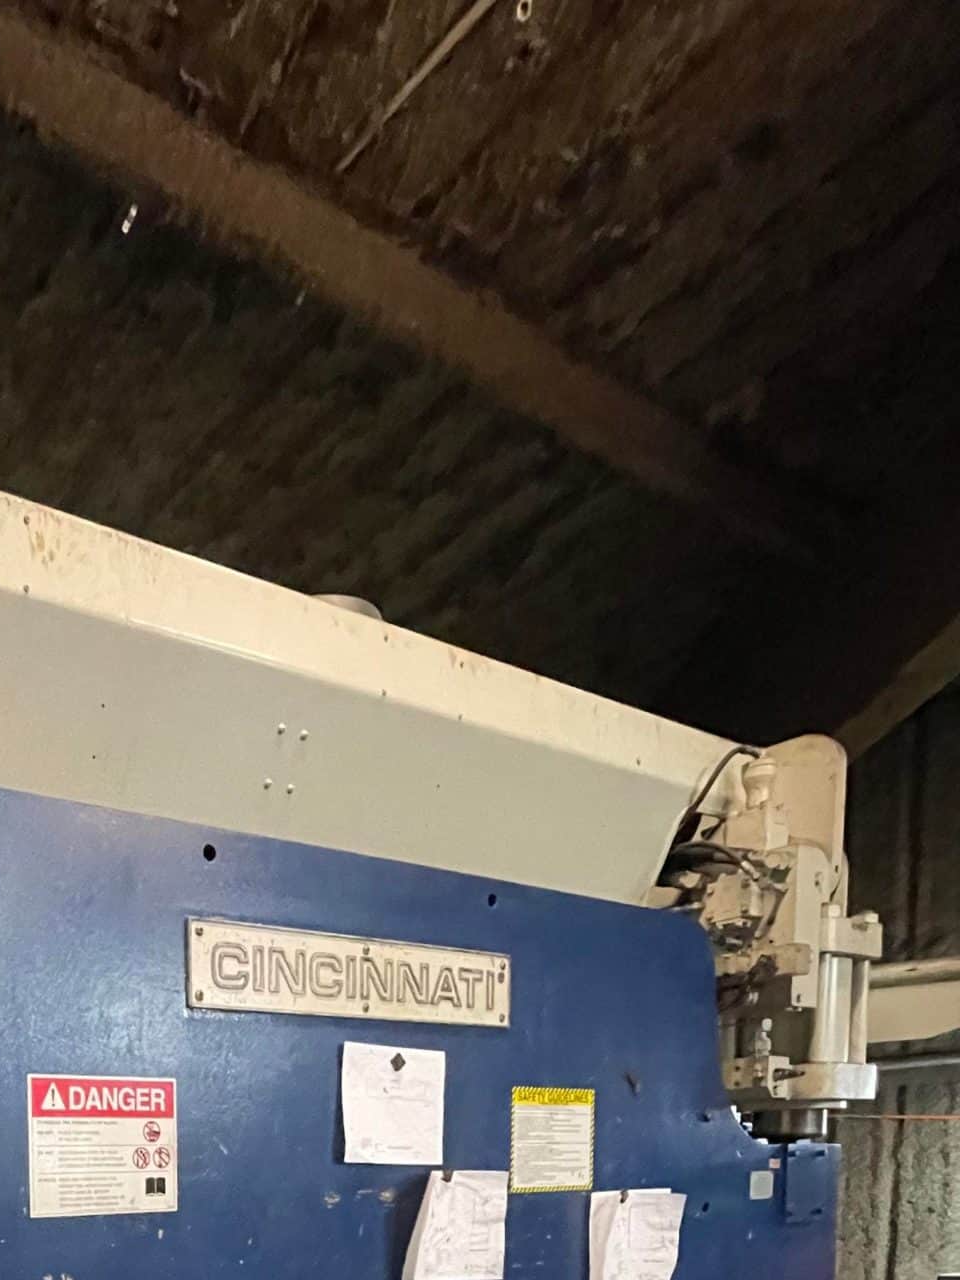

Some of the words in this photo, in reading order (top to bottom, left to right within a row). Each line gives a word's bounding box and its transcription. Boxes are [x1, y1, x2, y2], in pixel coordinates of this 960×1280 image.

[211, 941, 495, 1011] CINCINNATI
[69, 1086, 166, 1111] DANGER
[518, 1091, 545, 1102] SAFETY
